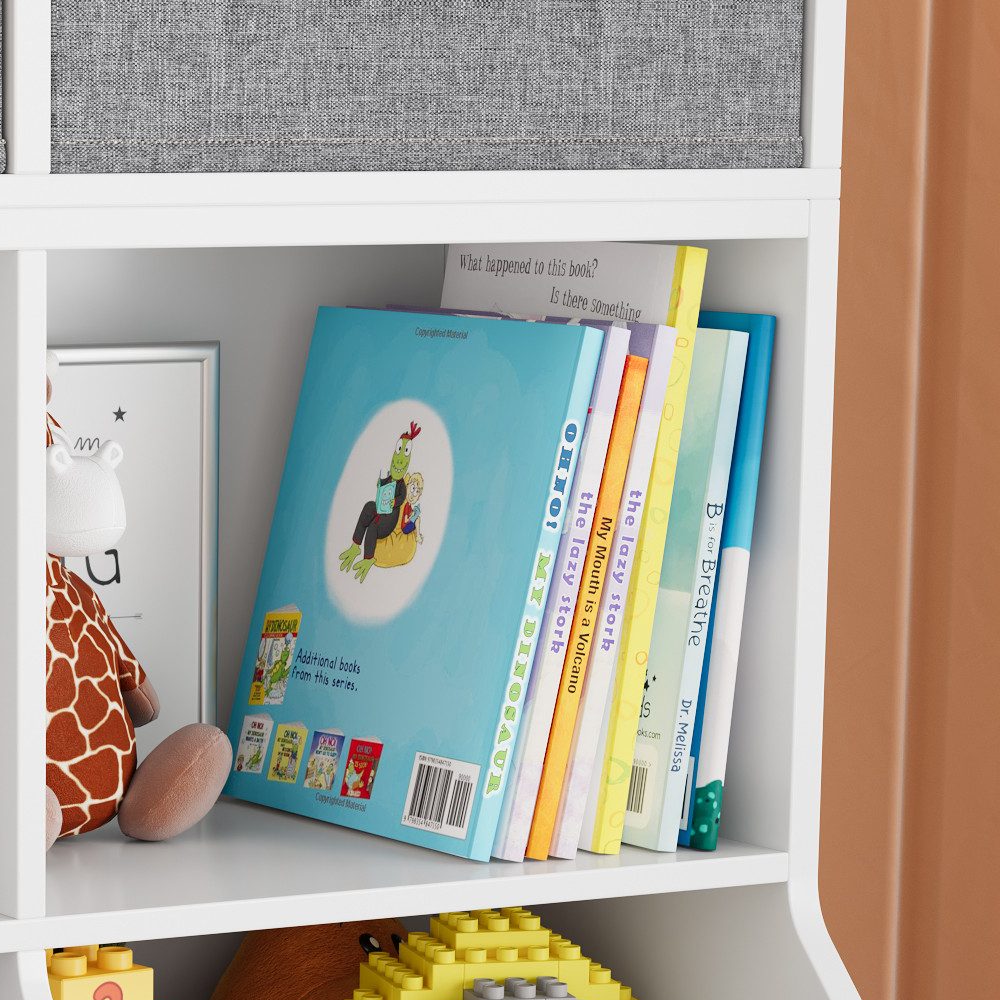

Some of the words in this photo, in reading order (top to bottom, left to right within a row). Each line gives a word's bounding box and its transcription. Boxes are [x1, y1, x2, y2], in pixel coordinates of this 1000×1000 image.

[460, 254, 482, 272] What
[485, 256, 531, 278] happened
[535, 259, 544, 275] to
[548, 258, 566, 277] this
[569, 258, 598, 278] book?
[550, 286, 559, 304] Is
[563, 289, 588, 311] there
[592, 297, 642, 323] something
[575, 492, 594, 529] the
[624, 490, 642, 527] the
[706, 503, 724, 519] B
[596, 516, 612, 540] My
[706, 536, 717, 554] for
[708, 522, 717, 533] is
[562, 537, 585, 586] lazy
[588, 545, 608, 596] Mouth
[612, 535, 634, 585] lazy
[530, 552, 551, 606] MY
[584, 599, 594, 613] is
[600, 592, 621, 652] stork
[687, 559, 716, 648] Breathe
[550, 595, 571, 654] stork
[582, 618, 590, 627] a
[292, 666, 312, 682] from
[314, 671, 329, 686] this
[332, 676, 358, 692] series.
[295, 648, 338, 669] Additional
[340, 657, 360, 675] books
[567, 632, 590, 694] Volcano
[486, 618, 536, 795] DINOSAUR
[679, 699, 692, 718] Dr.
[670, 722, 689, 773] Melissa
